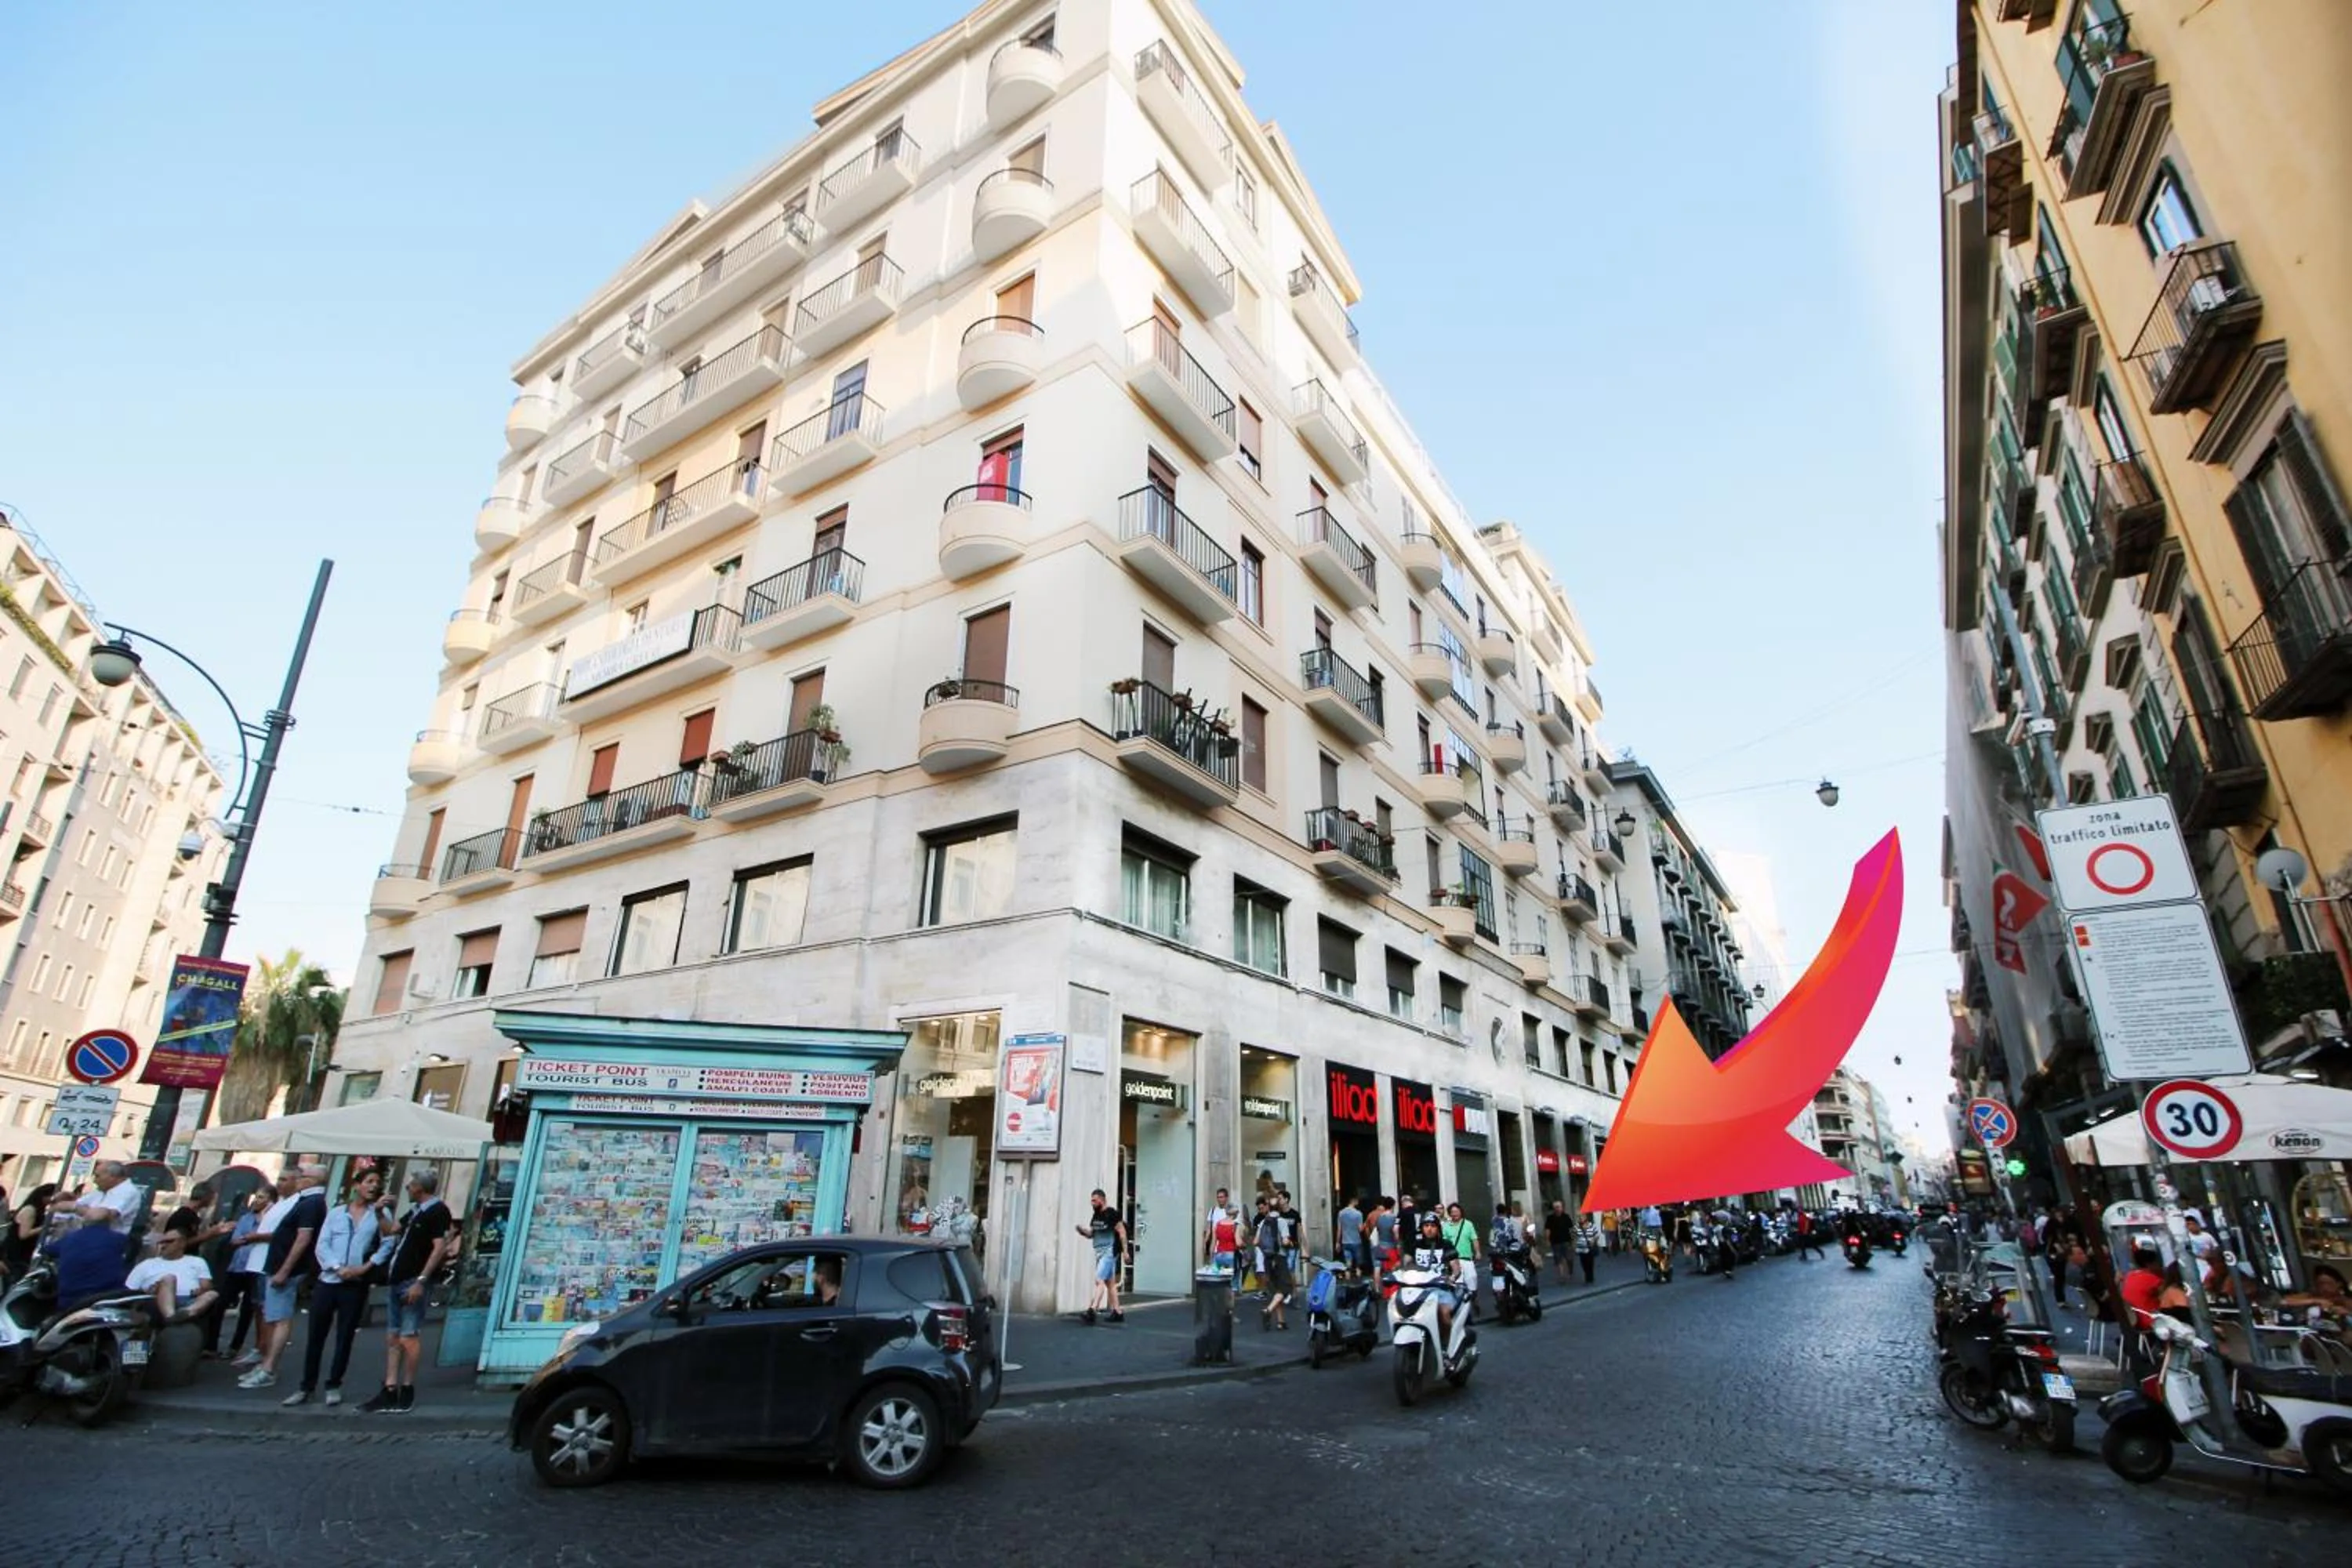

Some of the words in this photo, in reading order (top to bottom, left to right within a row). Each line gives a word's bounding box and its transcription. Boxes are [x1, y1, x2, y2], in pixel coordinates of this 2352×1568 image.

[2089, 811, 2122, 823] zona
[2050, 828, 2106, 844] traffico
[2110, 819, 2171, 837] limitato
[177, 973, 238, 991] CHAGALL
[527, 1061, 590, 1073] TICKET
[595, 1065, 649, 1076] POINT
[707, 1069, 754, 1078] POMPEII
[526, 1073, 602, 1084] TOURIST
[612, 1077, 649, 1087] BUS
[706, 1078, 792, 1087] HERCULANEUM
[812, 1074, 868, 1083] VESUVIUS
[1125, 1080, 1174, 1100] goldenpoint
[1330, 1071, 1378, 1123] iliad
[1244, 1098, 1280, 1116] goldenpoint
[2166, 1102, 2219, 1137] 30
